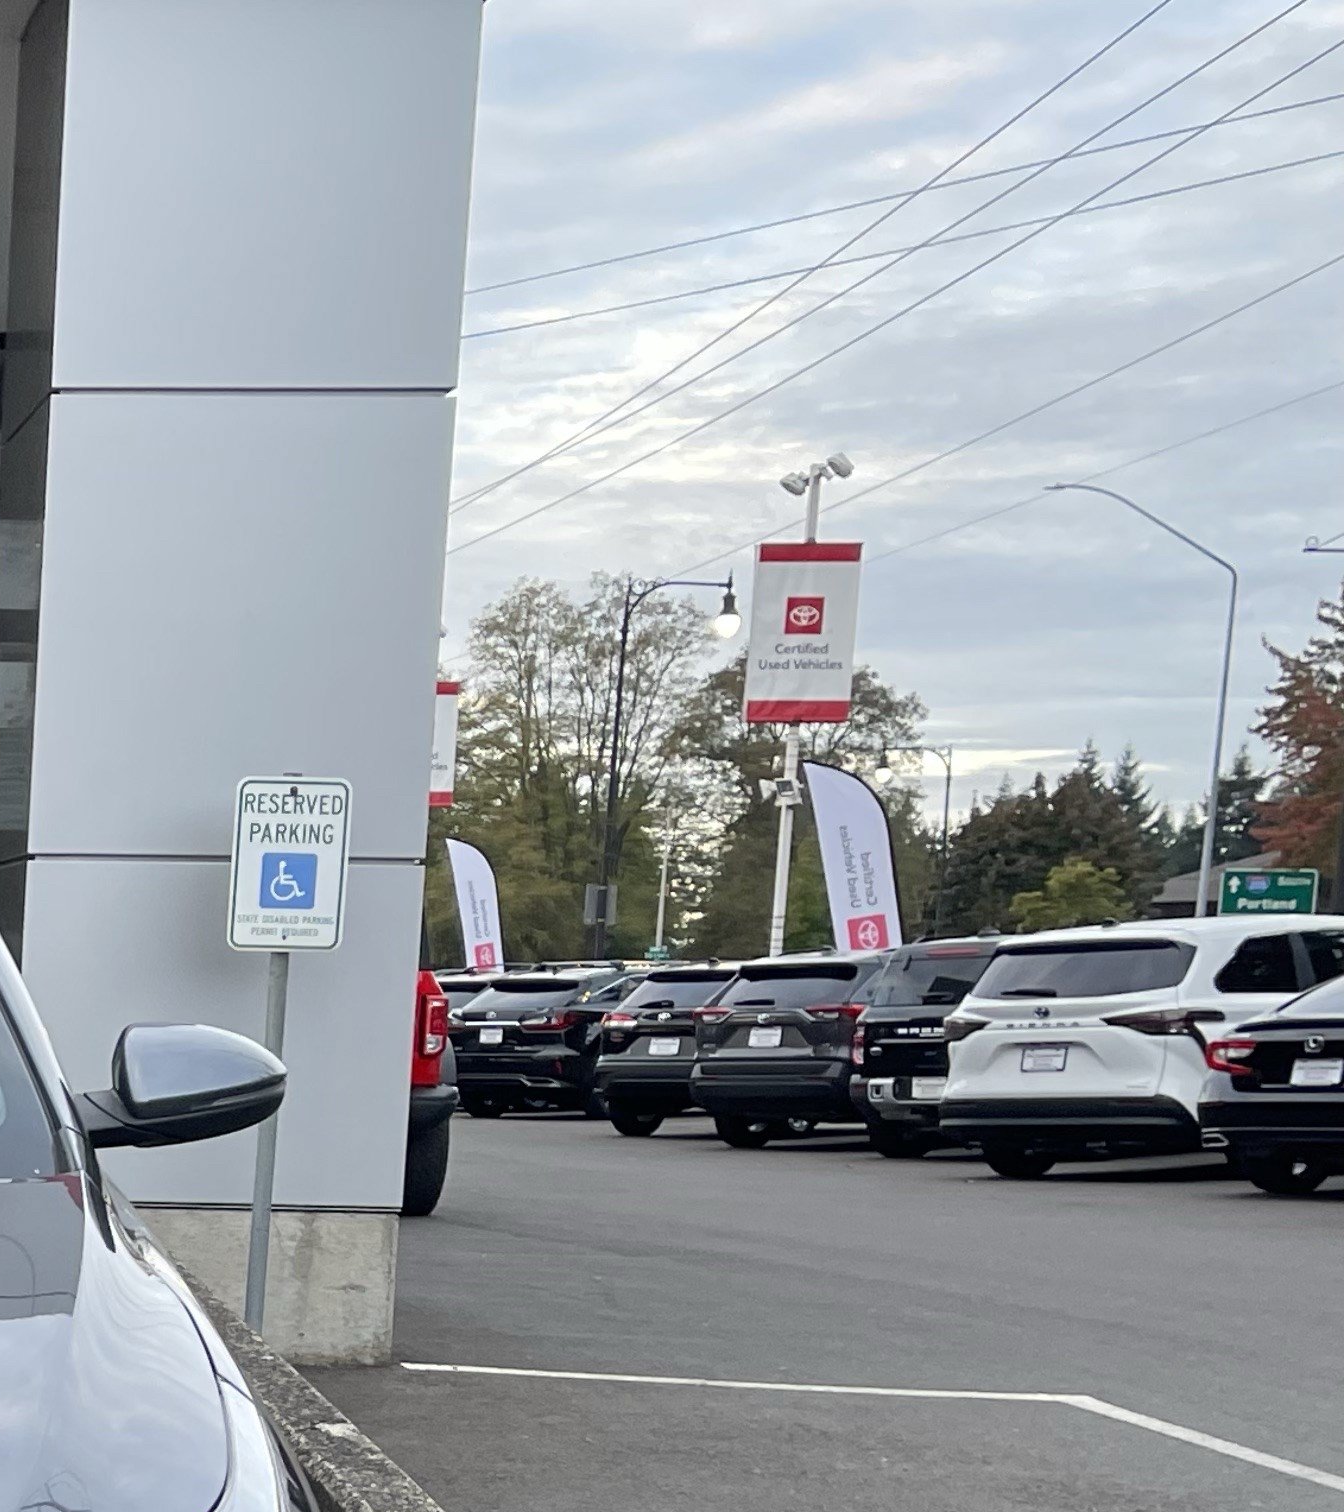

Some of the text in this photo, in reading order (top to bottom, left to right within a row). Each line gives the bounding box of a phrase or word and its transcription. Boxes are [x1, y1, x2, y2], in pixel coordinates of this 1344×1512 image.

[774, 643, 830, 654] Certified
[758, 659, 843, 670] Used Vehicles
[243, 793, 344, 816] RESERVED
[249, 822, 334, 845] PARKING
